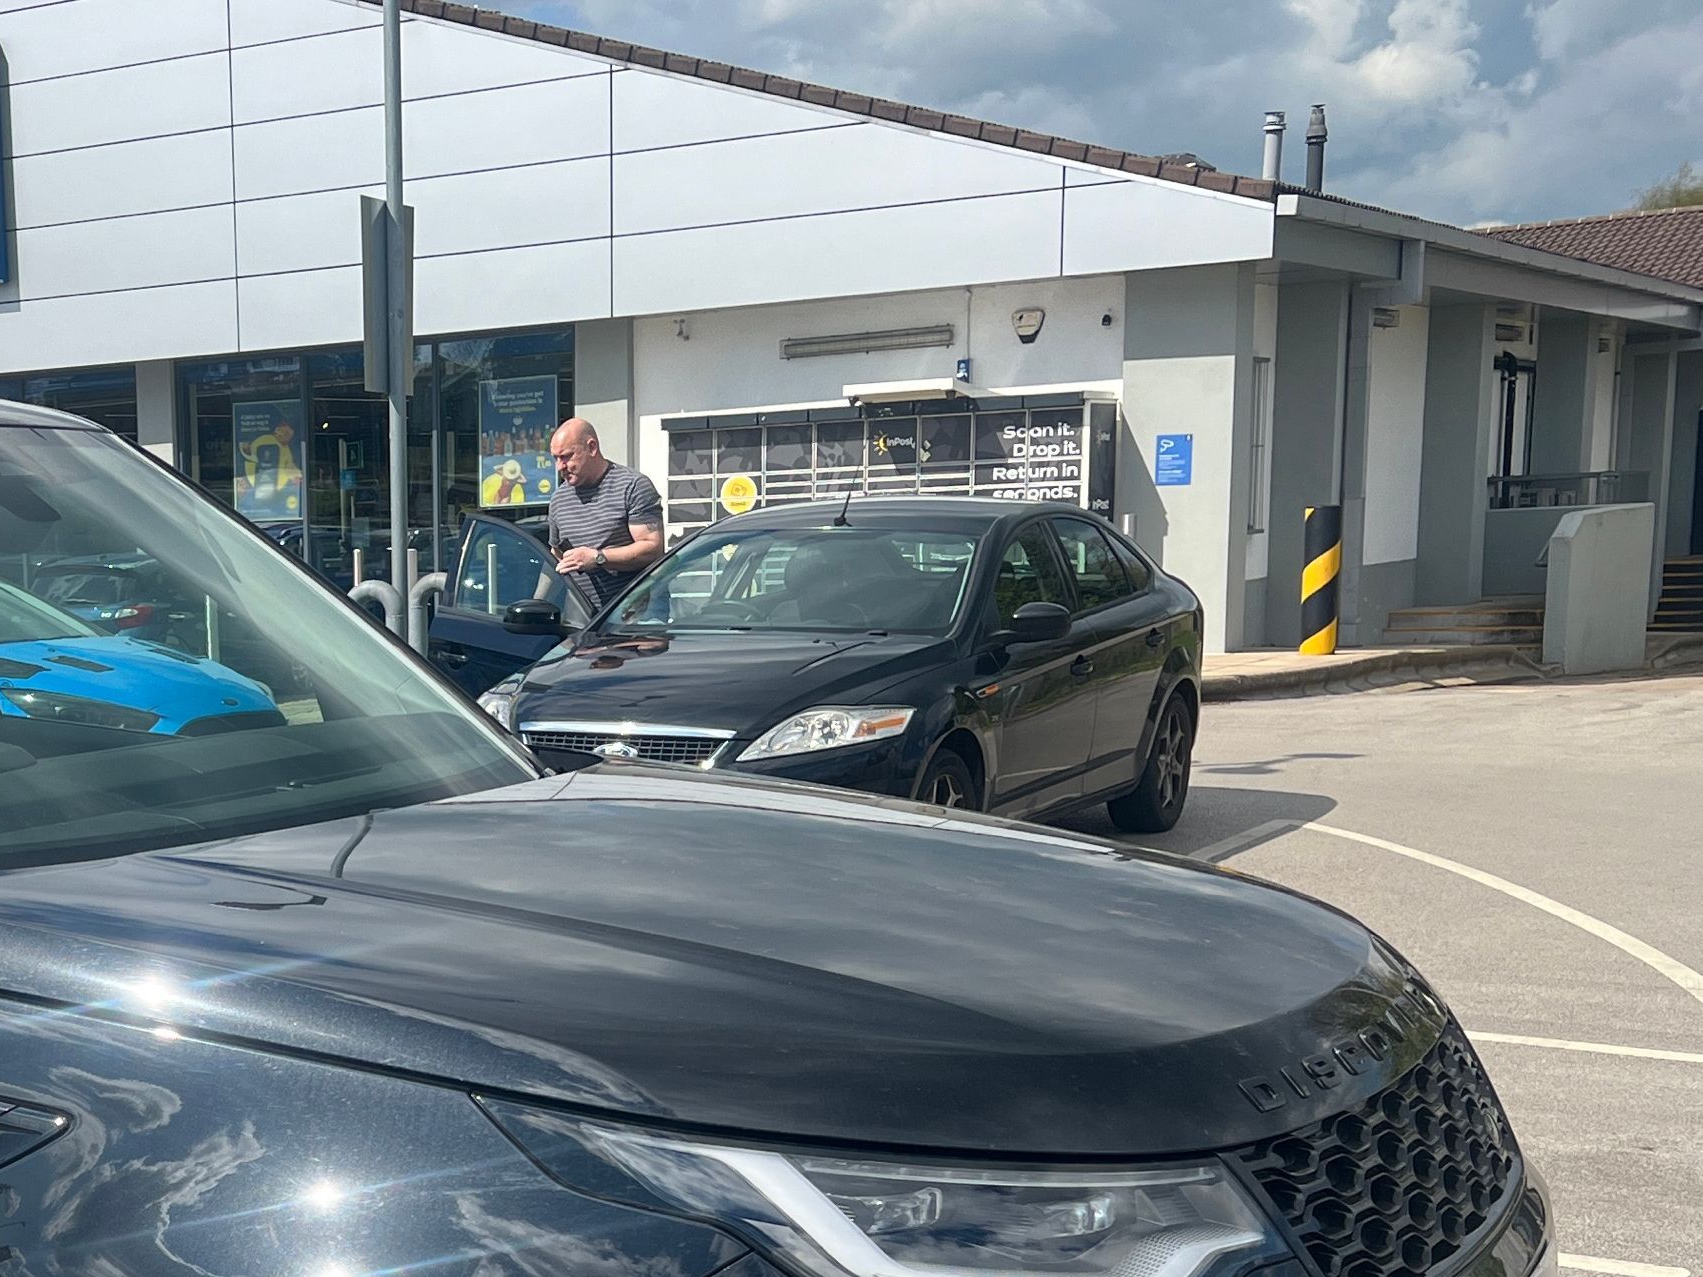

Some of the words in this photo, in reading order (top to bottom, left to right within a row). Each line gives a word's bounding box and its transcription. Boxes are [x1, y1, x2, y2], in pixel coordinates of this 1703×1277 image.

[1003, 425, 1054, 439] Scan
[1057, 421, 1076, 437] it.
[1012, 443, 1061, 459] Drop
[1062, 440, 1081, 455] it.
[992, 465, 1058, 481] Return
[1061, 462, 1079, 477] in
